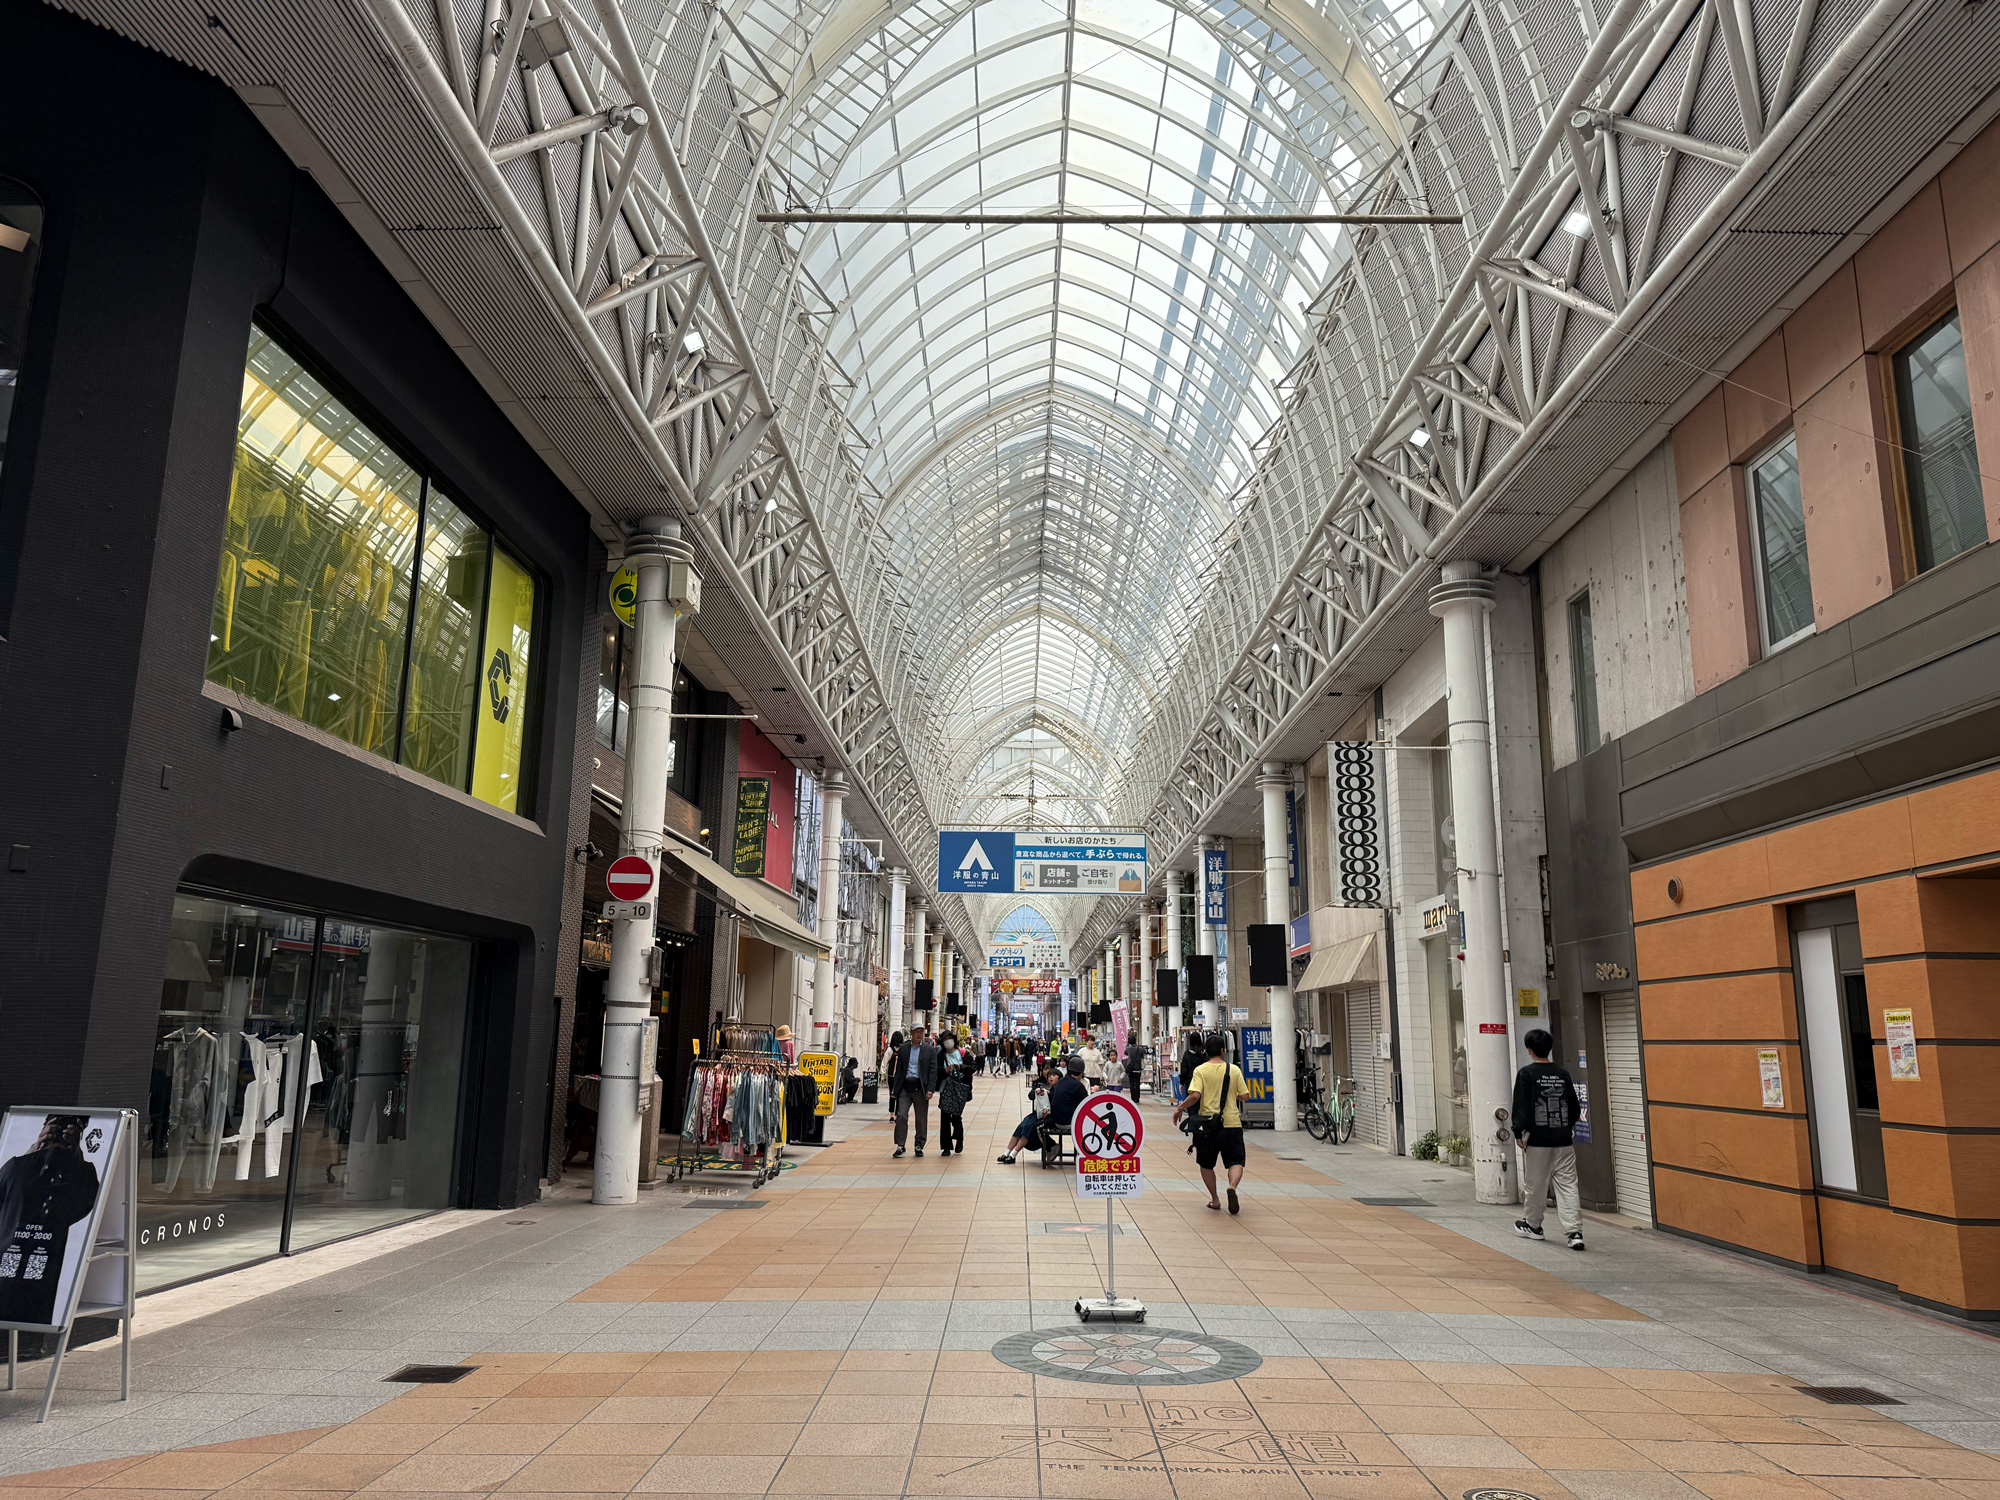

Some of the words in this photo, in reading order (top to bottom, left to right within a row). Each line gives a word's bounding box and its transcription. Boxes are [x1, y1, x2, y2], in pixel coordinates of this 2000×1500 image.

[741, 791, 767, 800] VINTAGE
[1044, 836, 1117, 845] 新しいお店のかたち
[953, 870, 999, 880] 洋服の青山
[1047, 868, 1071, 878] 店舗で
[1082, 868, 1114, 878] ご自宅で
[1208, 857, 1224, 918] 洋服の青山
[992, 958, 1023, 966] ヨネザワ
[802, 1058, 834, 1067] VINTAGE
[808, 1068, 829, 1076] SHOP
[141, 1213, 225, 1245] CRONOS
[1086, 1399, 1254, 1422] The
[1045, 1463, 1085, 1471] THE
[1300, 1469, 1382, 1477] STREET
